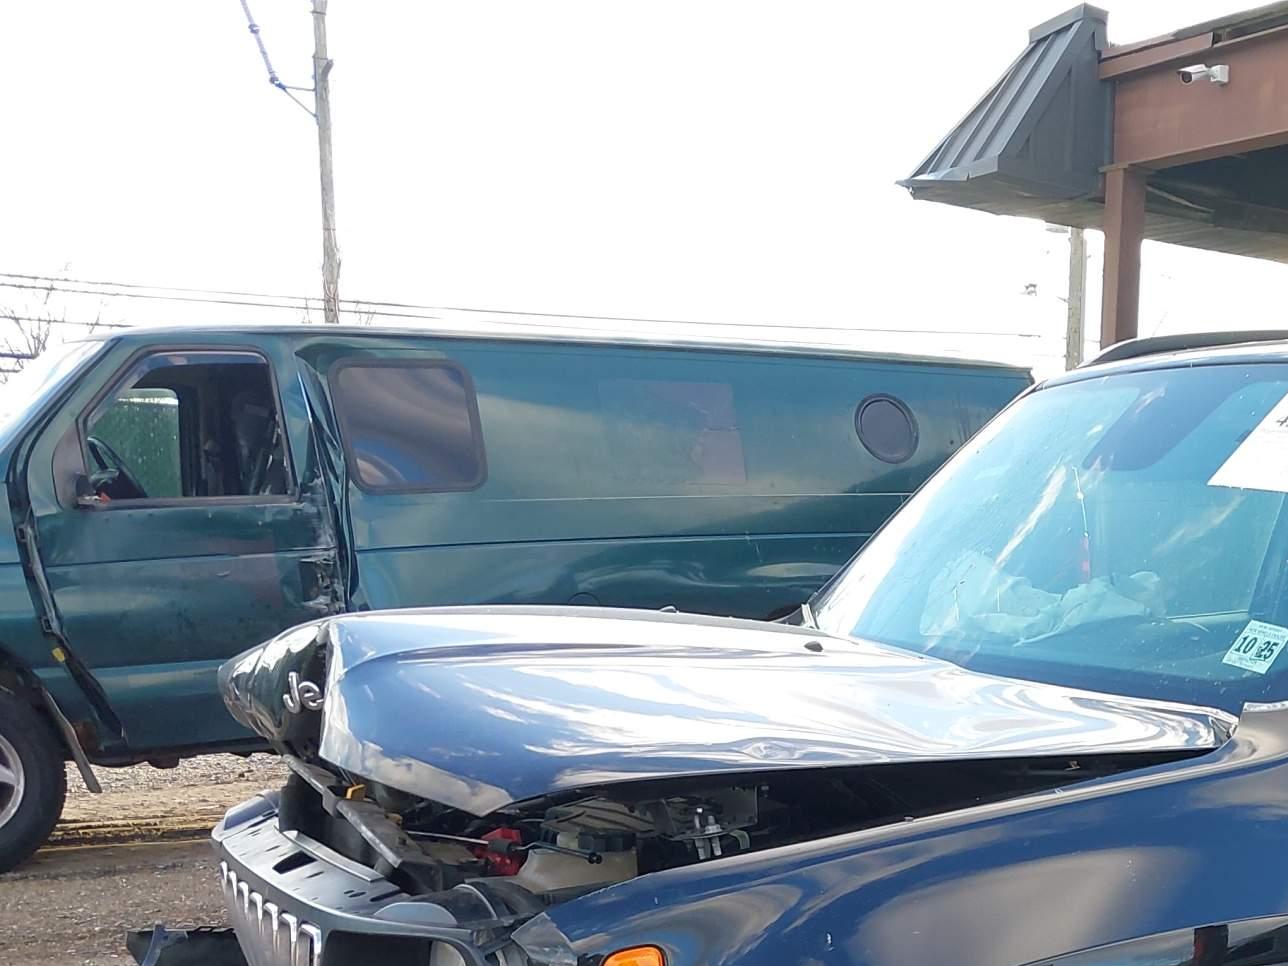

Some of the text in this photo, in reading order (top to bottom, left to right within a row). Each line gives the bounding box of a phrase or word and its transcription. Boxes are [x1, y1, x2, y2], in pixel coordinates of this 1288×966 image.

[1233, 634, 1280, 660] 10 25
[282, 671, 324, 714] Je
